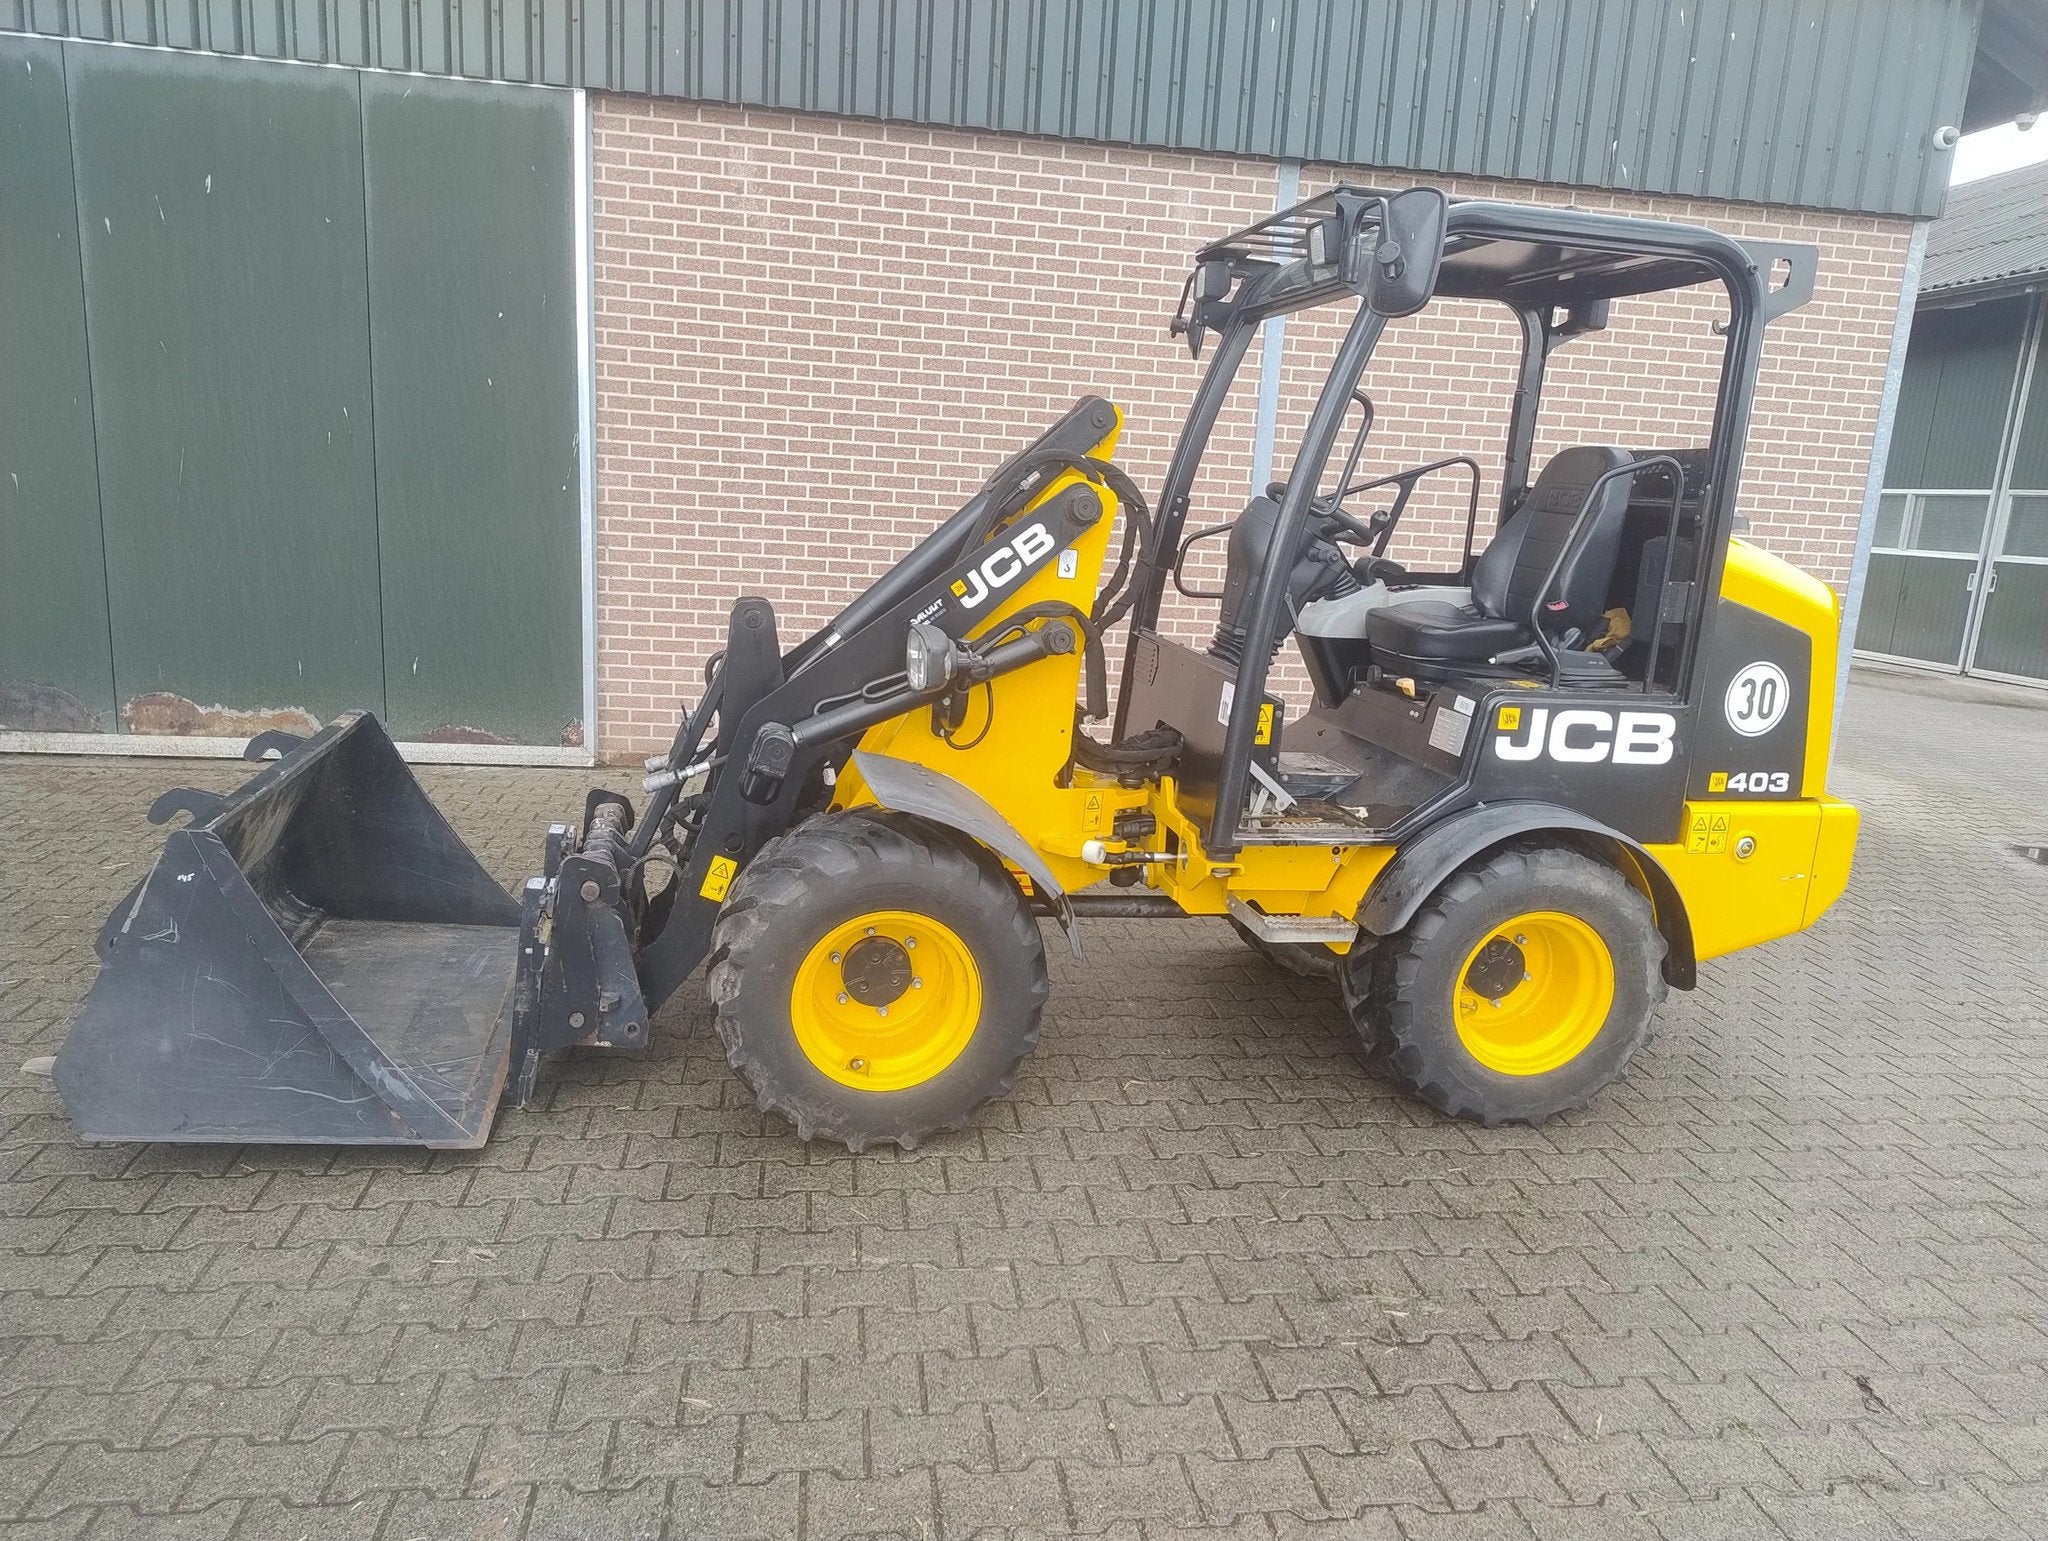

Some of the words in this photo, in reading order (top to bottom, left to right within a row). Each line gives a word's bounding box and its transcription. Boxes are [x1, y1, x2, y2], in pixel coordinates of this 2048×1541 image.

[960, 523, 1055, 609] JCB
[1737, 678, 1777, 720] 30
[1495, 708, 1676, 764] JCB
[1727, 772, 1790, 792] 403
